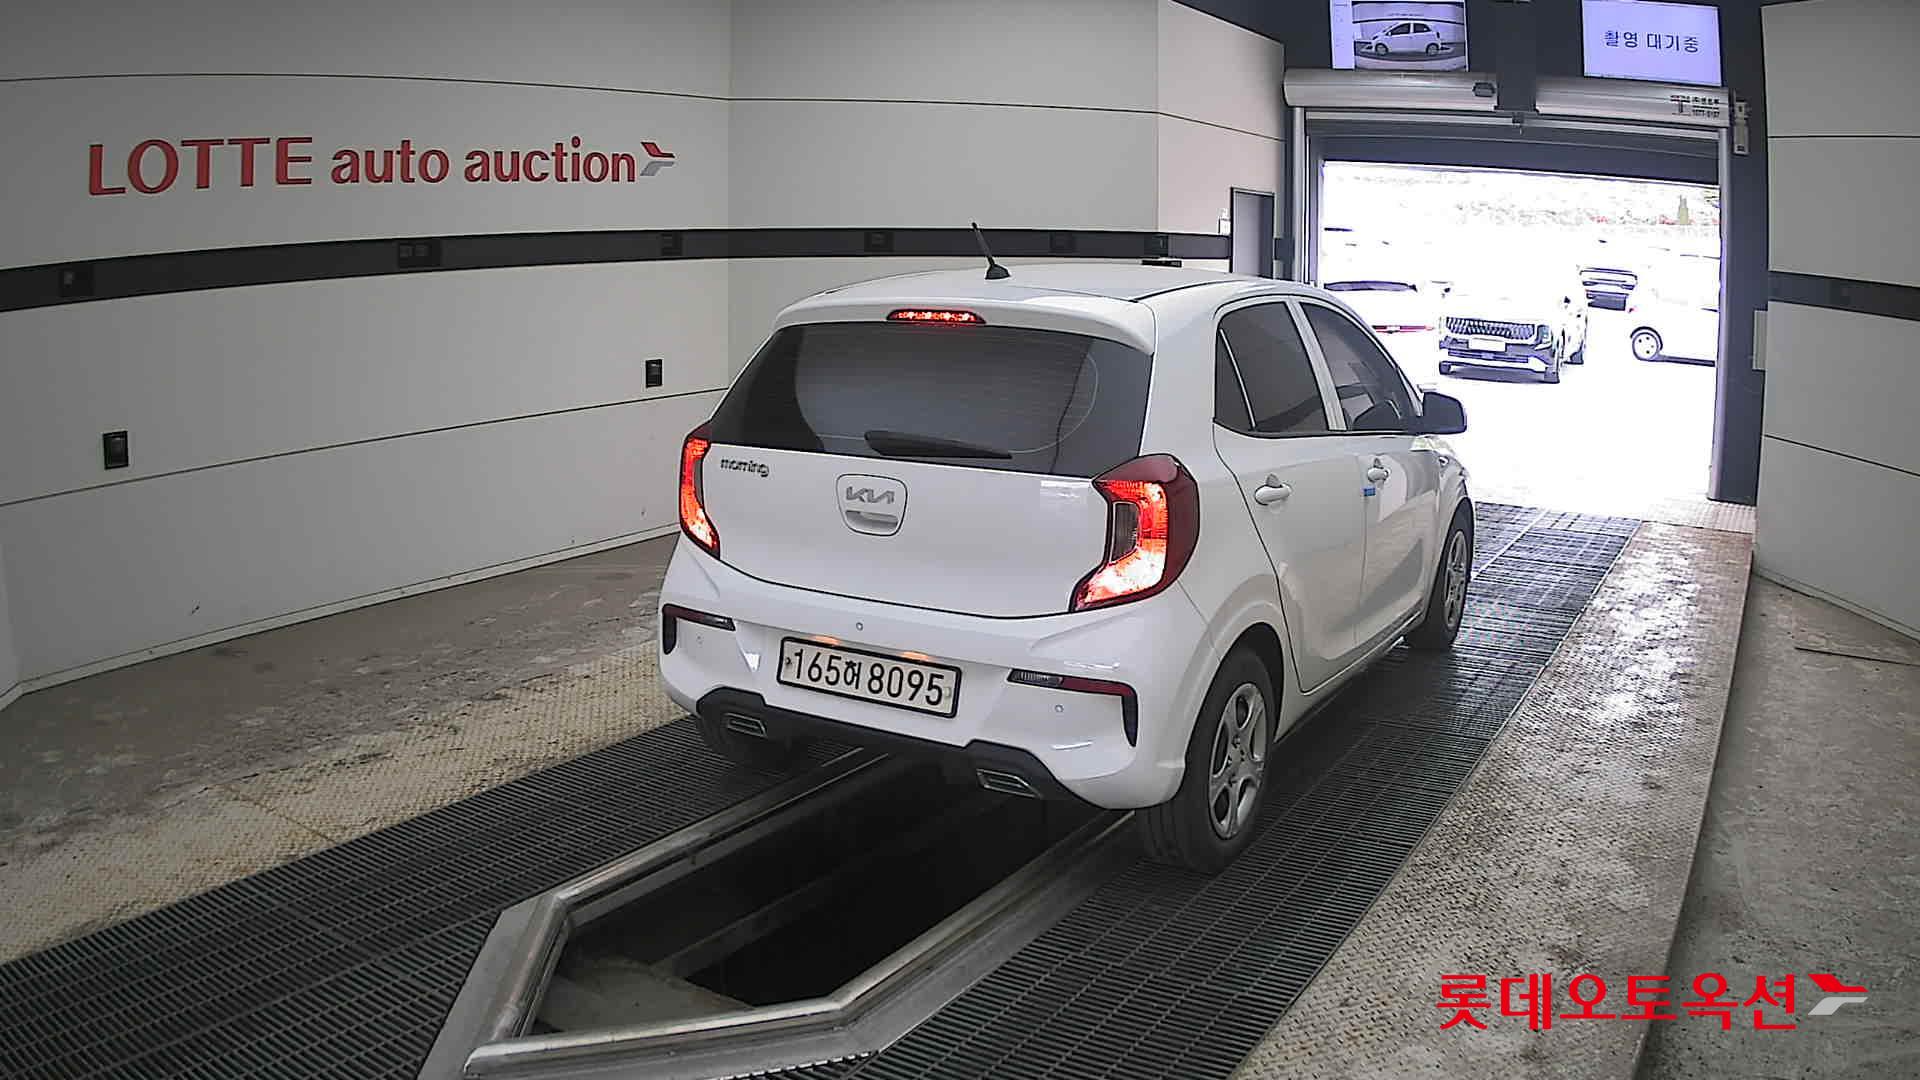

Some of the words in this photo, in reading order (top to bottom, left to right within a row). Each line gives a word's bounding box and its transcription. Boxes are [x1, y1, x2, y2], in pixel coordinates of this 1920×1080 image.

[1646, 33, 1699, 53] 대기중
[88, 136, 313, 196] LOTTE
[331, 139, 450, 184] auto
[463, 135, 636, 184] auction
[720, 458, 770, 477] morning
[867, 662, 945, 707] 8095
